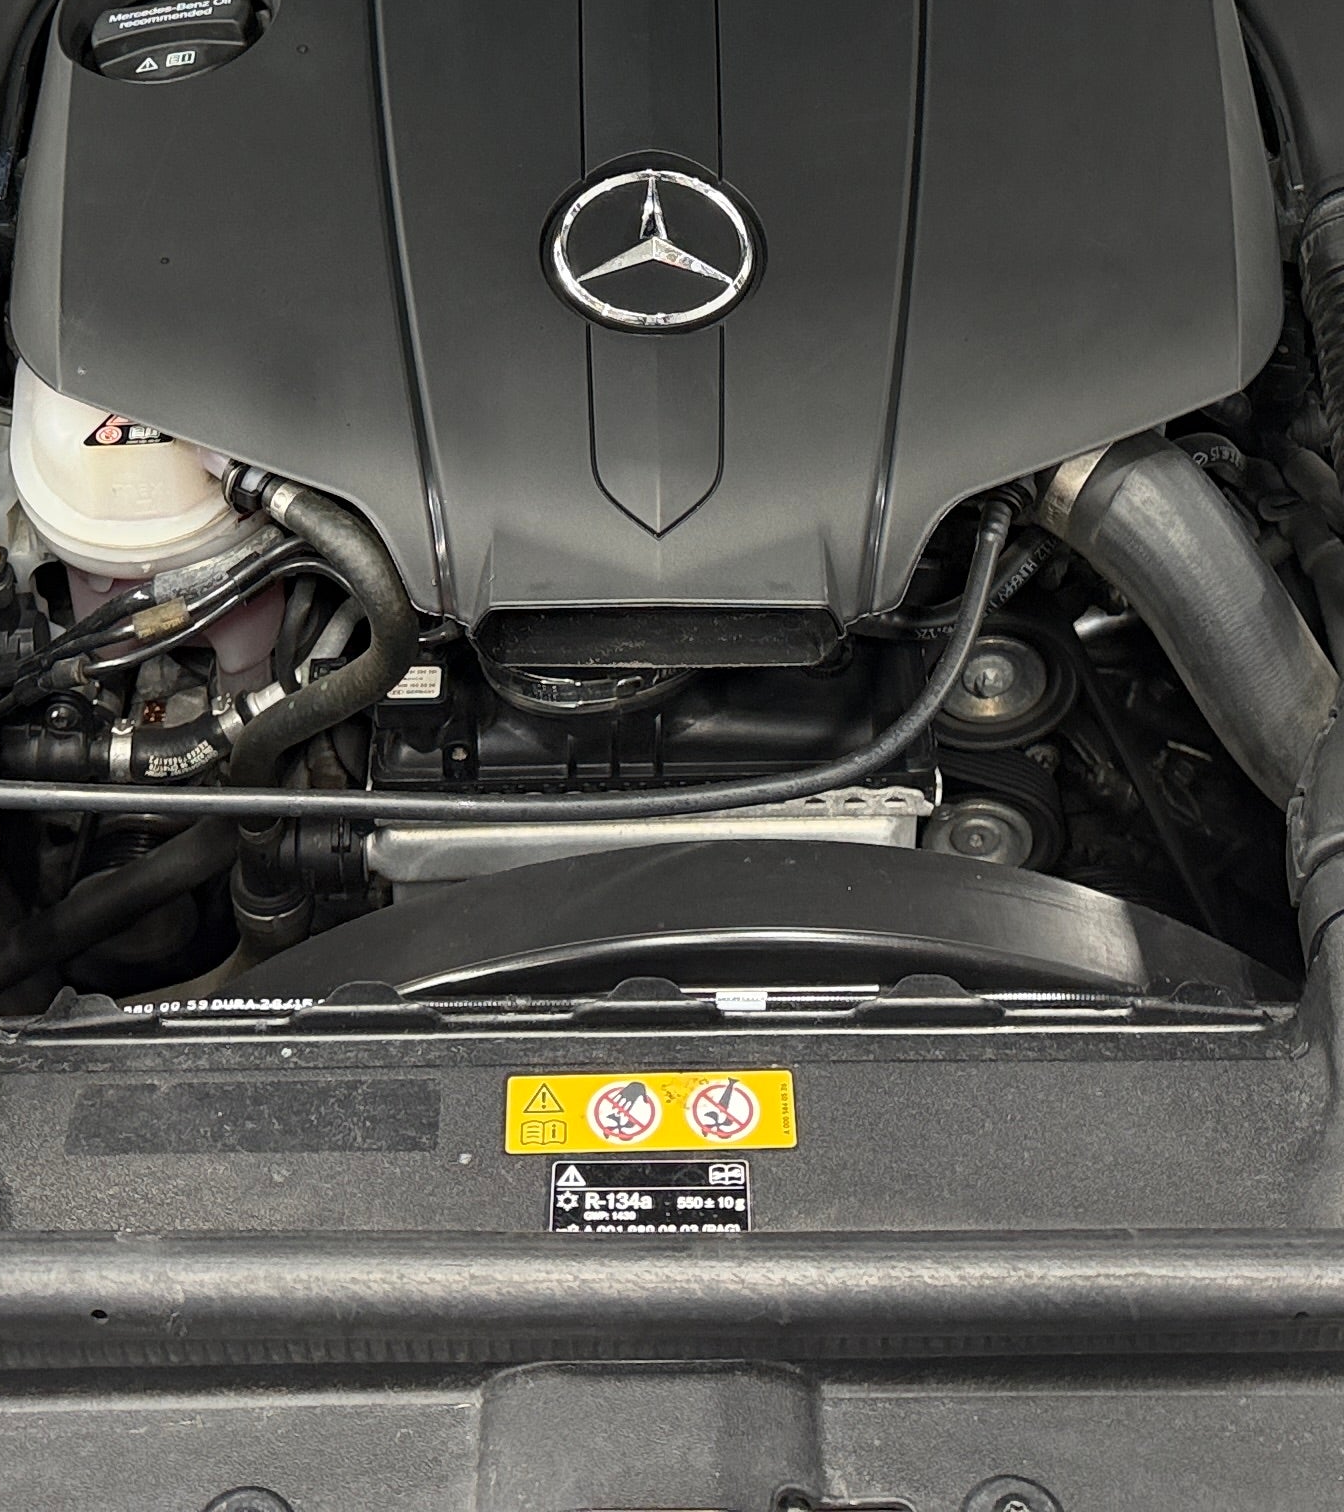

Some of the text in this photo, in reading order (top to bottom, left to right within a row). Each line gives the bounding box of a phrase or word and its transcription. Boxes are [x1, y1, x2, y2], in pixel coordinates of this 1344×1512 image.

[109, 0, 210, 23] Mercedes-Benz
[119, 7, 213, 29] recommended
[584, 1192, 653, 1210] R-134a
